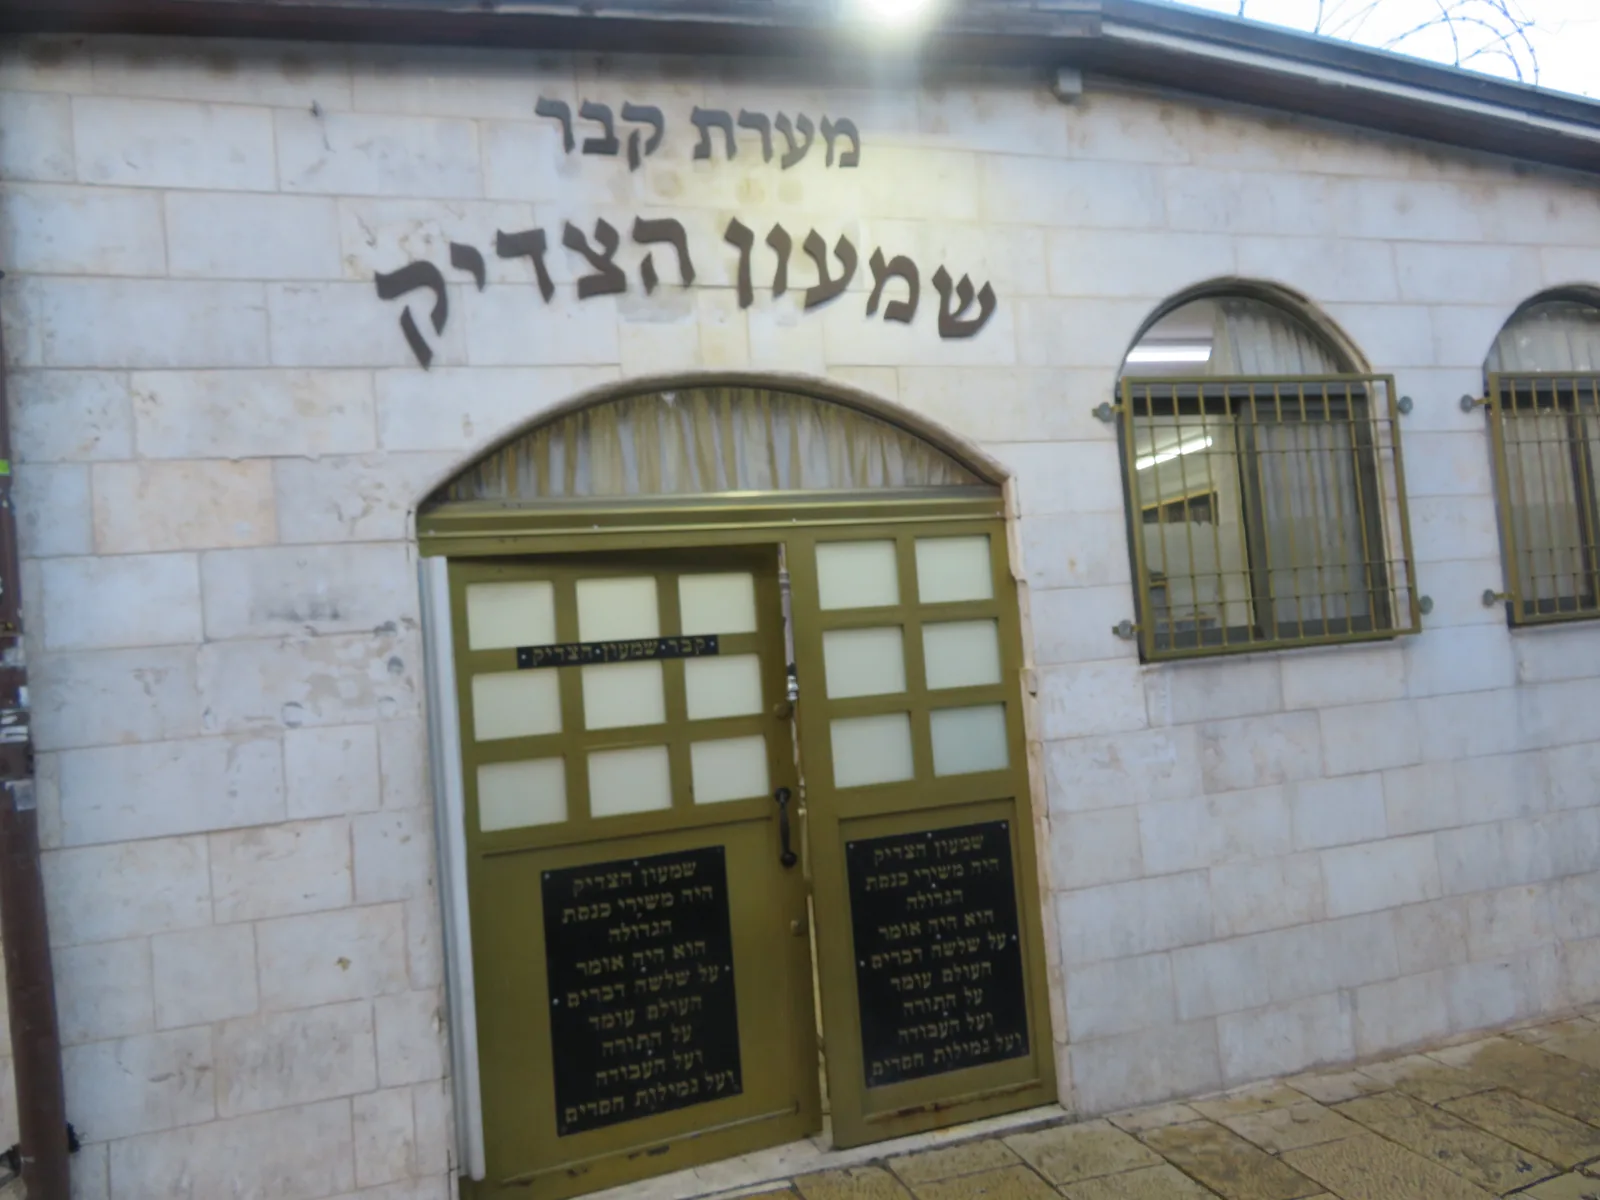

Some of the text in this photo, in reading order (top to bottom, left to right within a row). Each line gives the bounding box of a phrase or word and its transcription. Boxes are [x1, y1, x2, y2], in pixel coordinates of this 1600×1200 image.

[535, 97, 862, 172] מערת קבר
[375, 215, 998, 371] שמעון הצדיק
[532, 636, 706, 667] קבר שמעון הצדיק
[874, 835, 984, 867] שמעון הצדיק
[971, 858, 999, 875] היה
[573, 861, 697, 897] שמעון הצדיק
[682, 885, 713, 902] היה
[865, 872, 909, 891] כנסת
[562, 902, 612, 924] כנסת
[906, 888, 963, 911] הגדולה
[609, 920, 672, 943] הגדולה
[878, 909, 994, 940] הוא היה אומר
[576, 941, 705, 976] הוא היה אומר
[871, 930, 1006, 970] על שלשה דברים
[567, 962, 719, 1008] על שלשה דברים
[890, 961, 991, 991] העולם עומד
[589, 995, 702, 1030] העולם עומד
[903, 986, 983, 1016] על התורה
[602, 1023, 692, 1056] על התורה
[898, 1012, 993, 1044] ועל העבודה
[596, 1049, 703, 1086] ועל העבודה
[871, 1032, 1022, 1077] ועל גמילות חסדים
[565, 1070, 734, 1124] ועל גמילות חסדים
